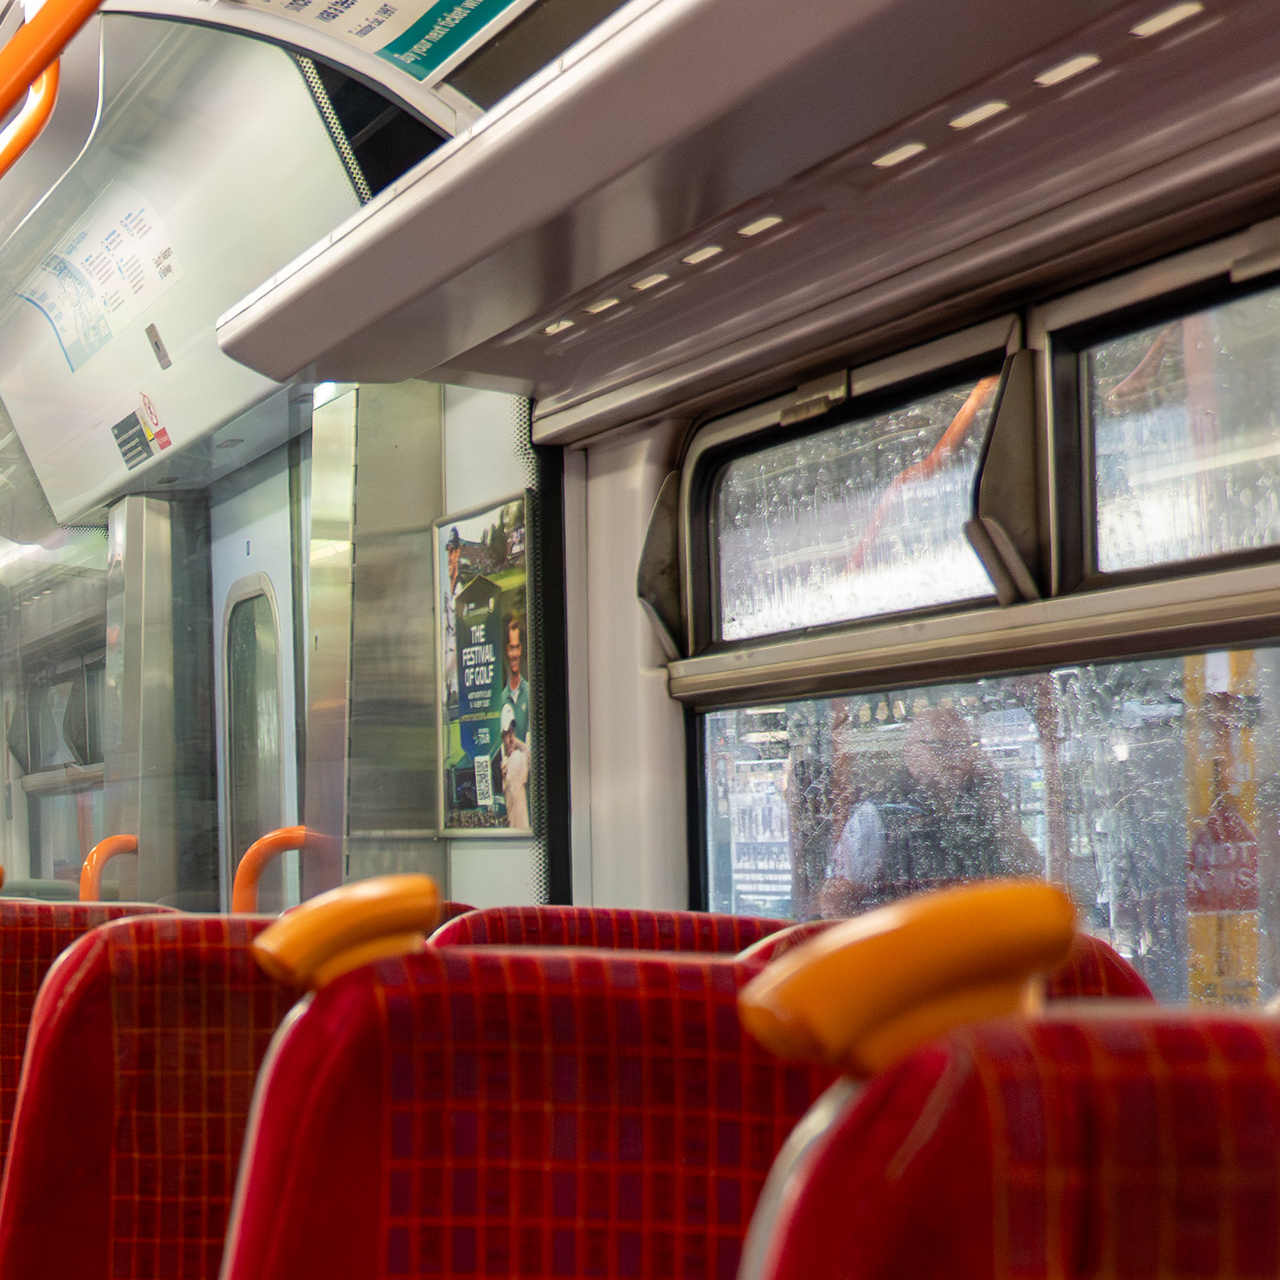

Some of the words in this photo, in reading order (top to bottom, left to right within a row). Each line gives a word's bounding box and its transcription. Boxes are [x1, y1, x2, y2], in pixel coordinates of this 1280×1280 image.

[436, 5, 471, 28] ticket
[424, 25, 450, 43] next
[411, 38, 433, 56] your
